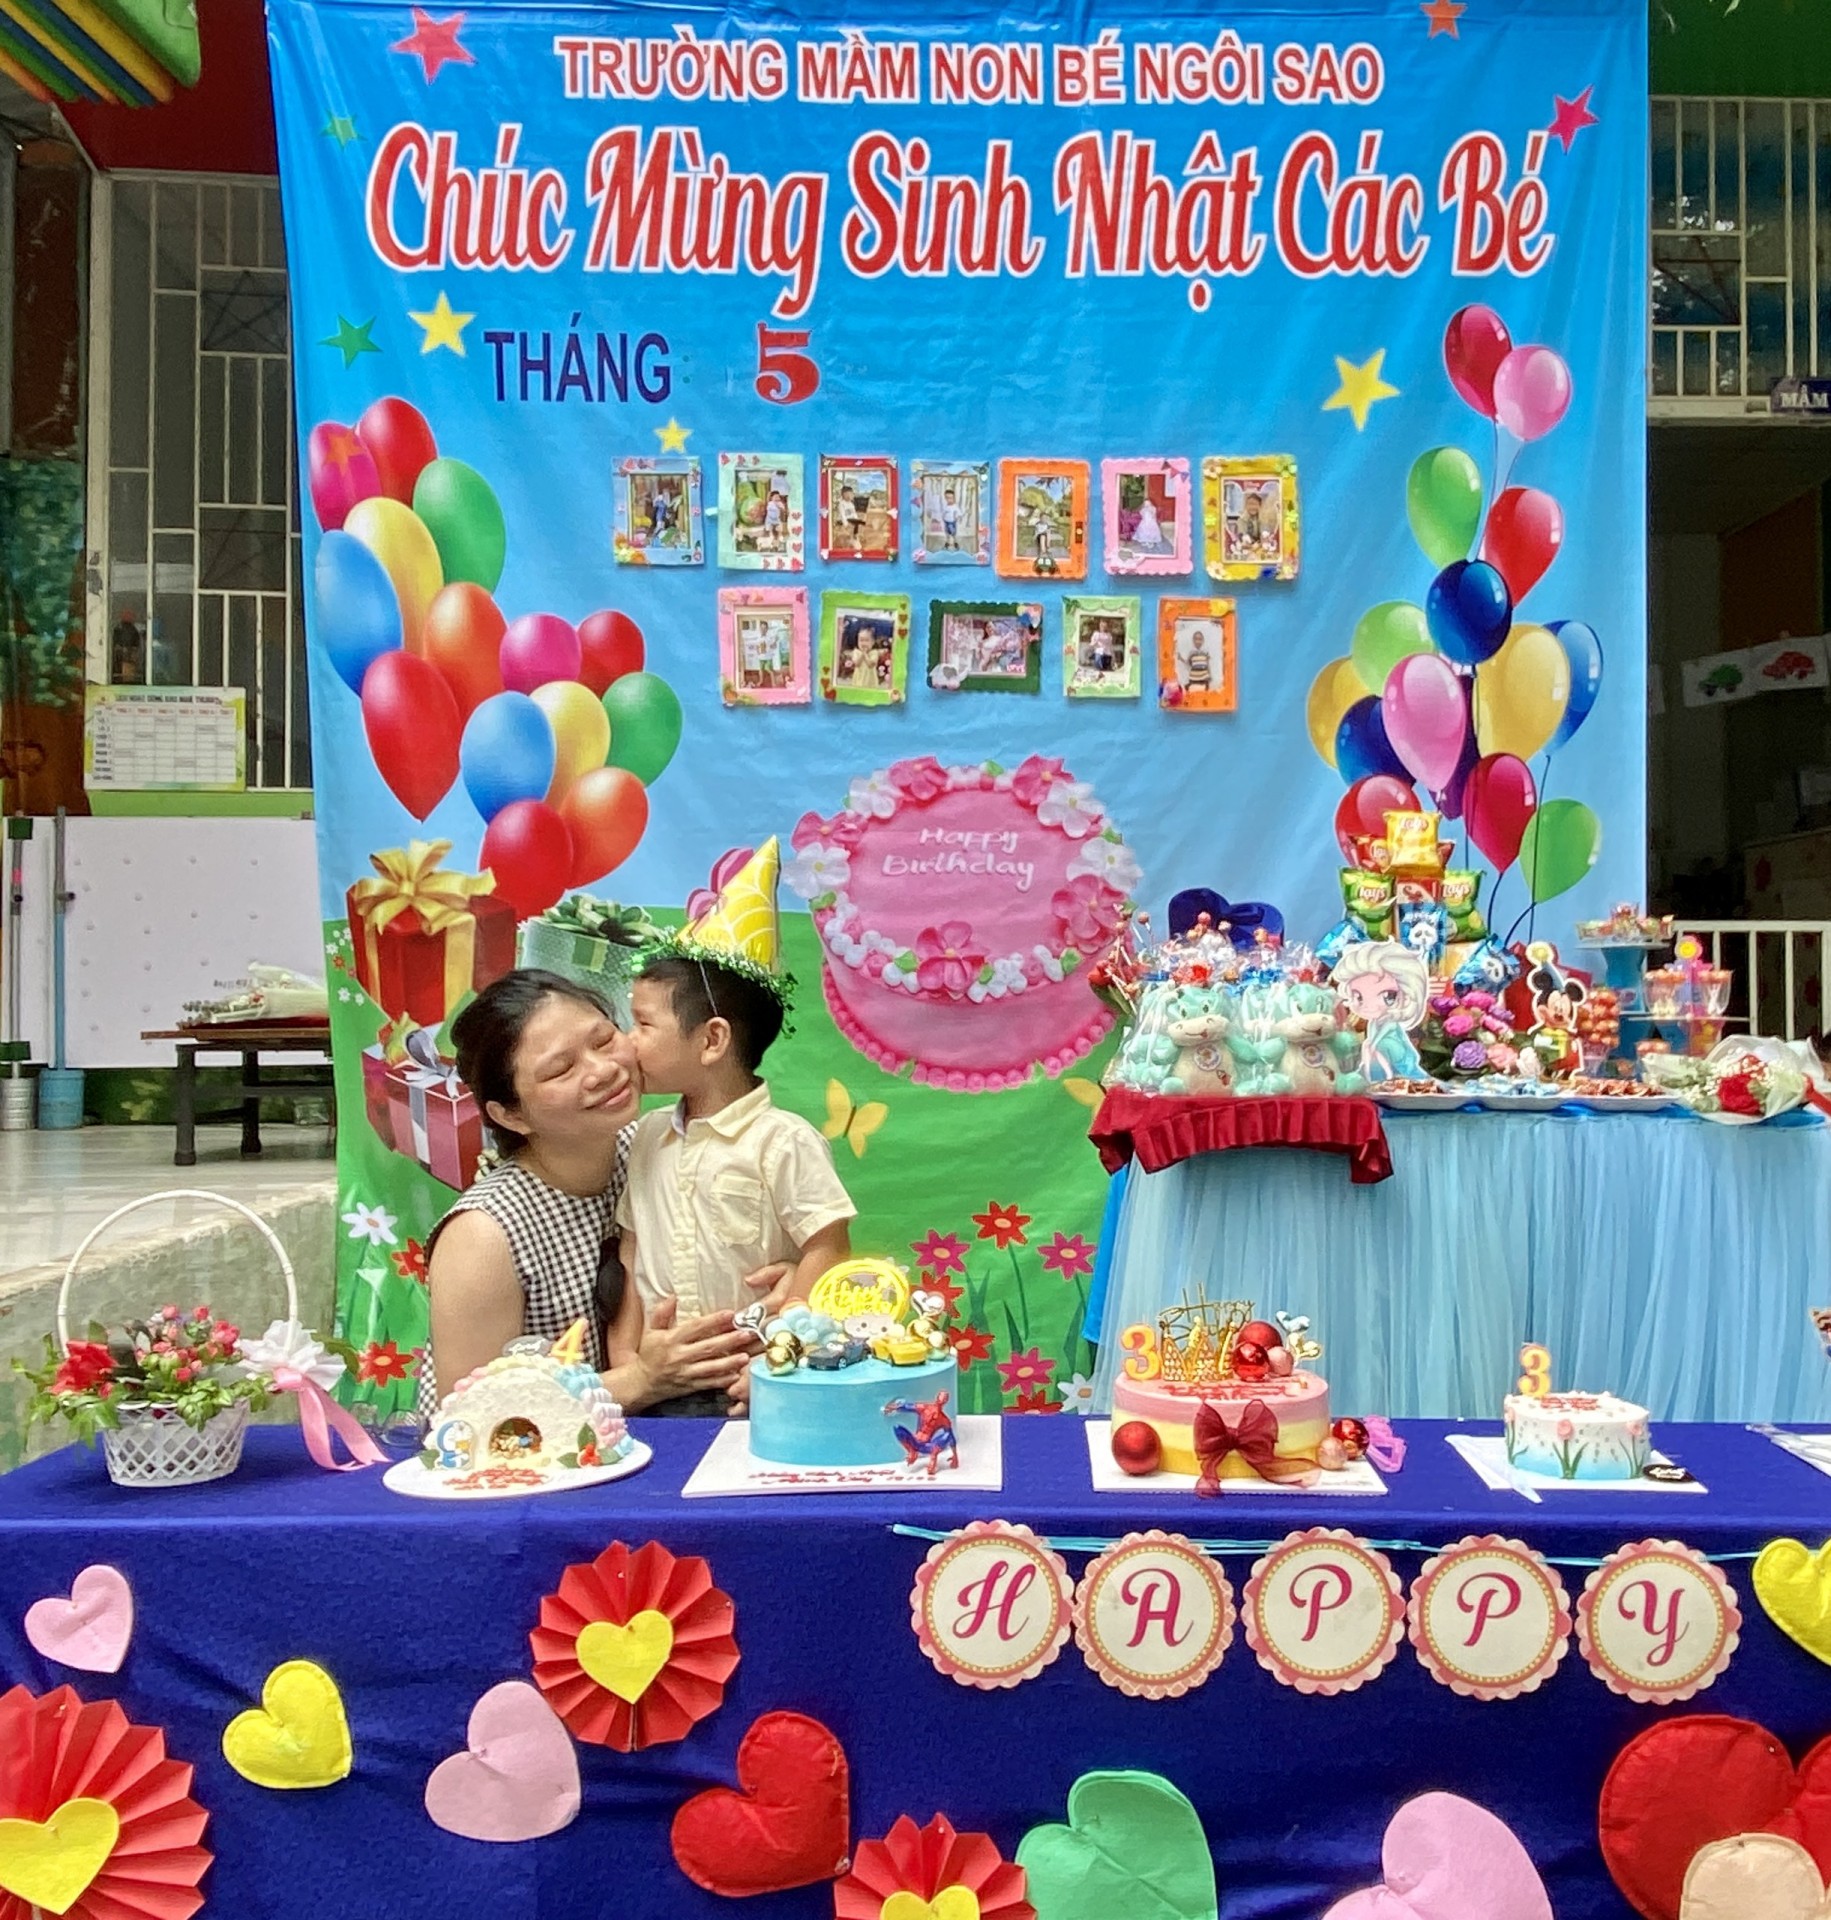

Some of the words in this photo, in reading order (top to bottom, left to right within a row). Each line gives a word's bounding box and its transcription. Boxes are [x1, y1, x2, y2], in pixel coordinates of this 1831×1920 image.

[557, 28, 785, 99] TRƯỜNG
[800, 30, 917, 101] MẦM
[933, 45, 1041, 102] NON
[1056, 32, 1124, 103] BÉ
[1136, 32, 1261, 102] NGÔI
[1275, 45, 1382, 102] SAO
[368, 122, 572, 270] Chúc
[587, 127, 826, 317] Mừng
[841, 132, 1042, 276] Sinh
[1053, 130, 1264, 309] Nhật
[1274, 131, 1430, 277] Các
[1440, 131, 1553, 276] Bé
[754, 321, 821, 405] 5
[919, 827, 1019, 854] Happy
[882, 851, 1035, 893] Birthday
[548, 1316, 589, 1366] 4
[1120, 1322, 1162, 1382] 3
[1517, 1344, 1552, 1398] 3
